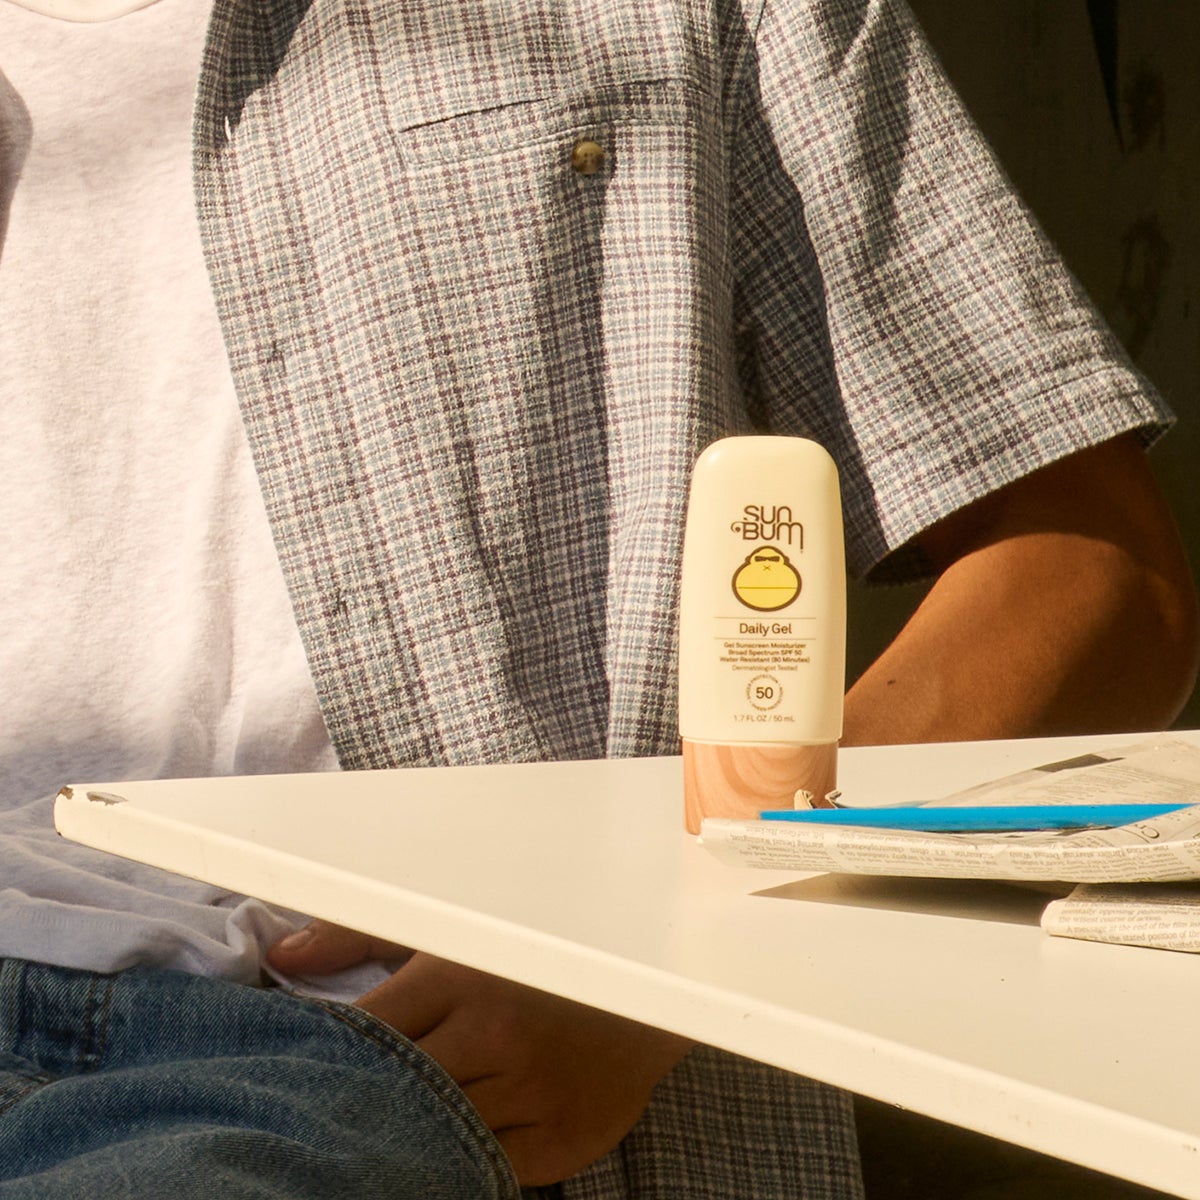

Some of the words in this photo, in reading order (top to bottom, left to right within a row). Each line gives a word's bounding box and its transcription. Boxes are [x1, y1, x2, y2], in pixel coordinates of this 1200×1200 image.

[739, 623, 770, 637] Daily
[771, 623, 792, 634] Gel
[756, 686, 774, 699] 50
